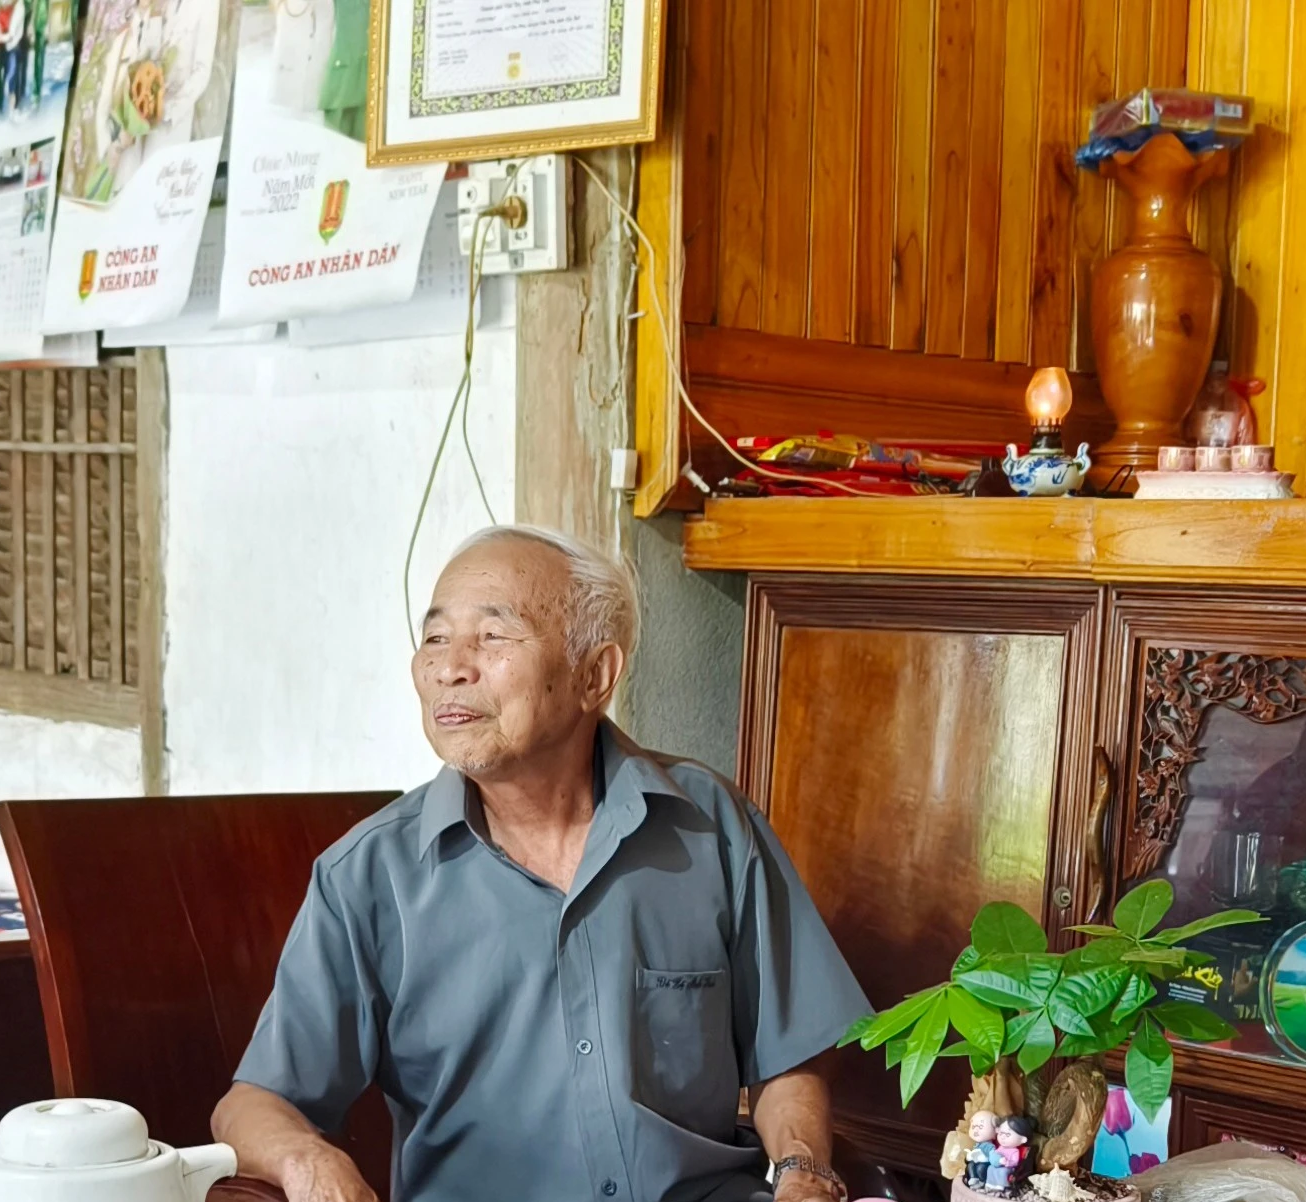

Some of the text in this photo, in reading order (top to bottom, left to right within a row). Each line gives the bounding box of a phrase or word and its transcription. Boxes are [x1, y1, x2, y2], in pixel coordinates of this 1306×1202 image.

[105, 244, 159, 268] CÔNG AN
[249, 243, 400, 287] CÔNG AN NHÂN DÂN
[97, 266, 159, 292] NHÂN DÂN
